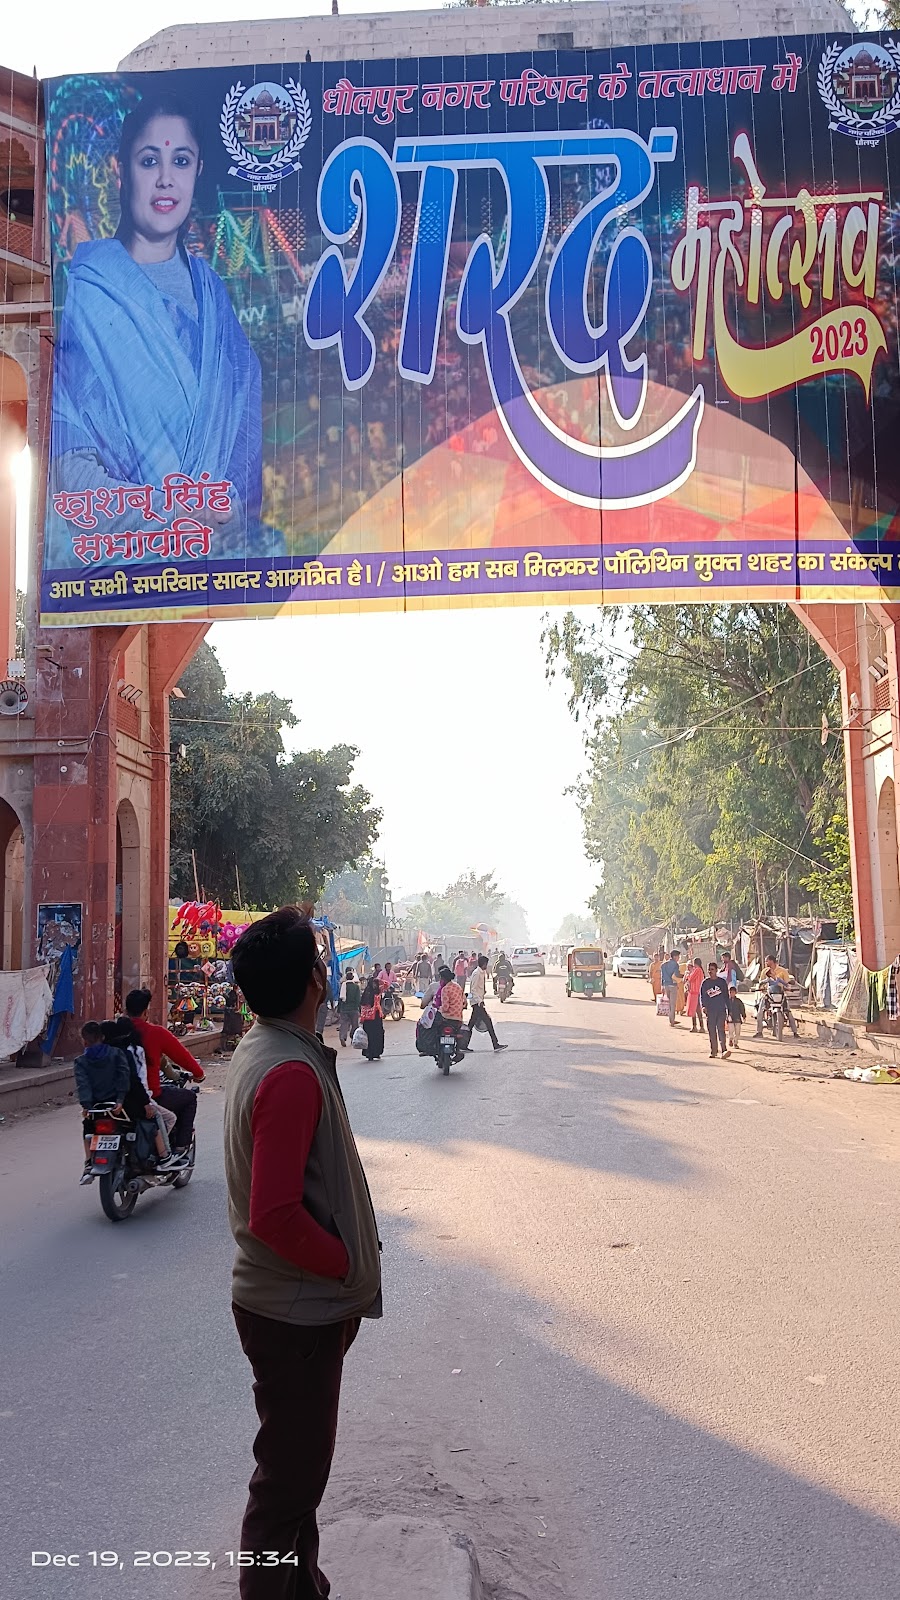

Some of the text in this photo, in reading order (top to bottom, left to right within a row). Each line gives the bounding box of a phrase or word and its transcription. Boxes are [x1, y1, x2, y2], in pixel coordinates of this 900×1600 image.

[322, 52, 803, 125] धौलपुर नगर परिषद के तत्वाधान में
[670, 131, 888, 404] महोत्सव
[303, 127, 704, 510] शरद
[810, 317, 869, 364] 2023
[53, 472, 232, 529] खुशबू सिंह
[72, 517, 213, 565] सभापति
[49, 580, 85, 599] आप
[89, 570, 129, 597] सभी
[132, 567, 209, 593] सपरिवार
[212, 570, 262, 591] सादर
[264, 560, 343, 588] आमंत्रित
[391, 556, 443, 584] आओ
[447, 560, 480, 582] हम
[485, 559, 519, 579] सब
[524, 551, 600, 578] मिलकर
[604, 548, 689, 575] पॉलिथिन
[693, 553, 743, 582] मुक्त
[747, 552, 794, 573] शहर
[797, 552, 825, 571] का
[829, 546, 894, 571] संकल्प
